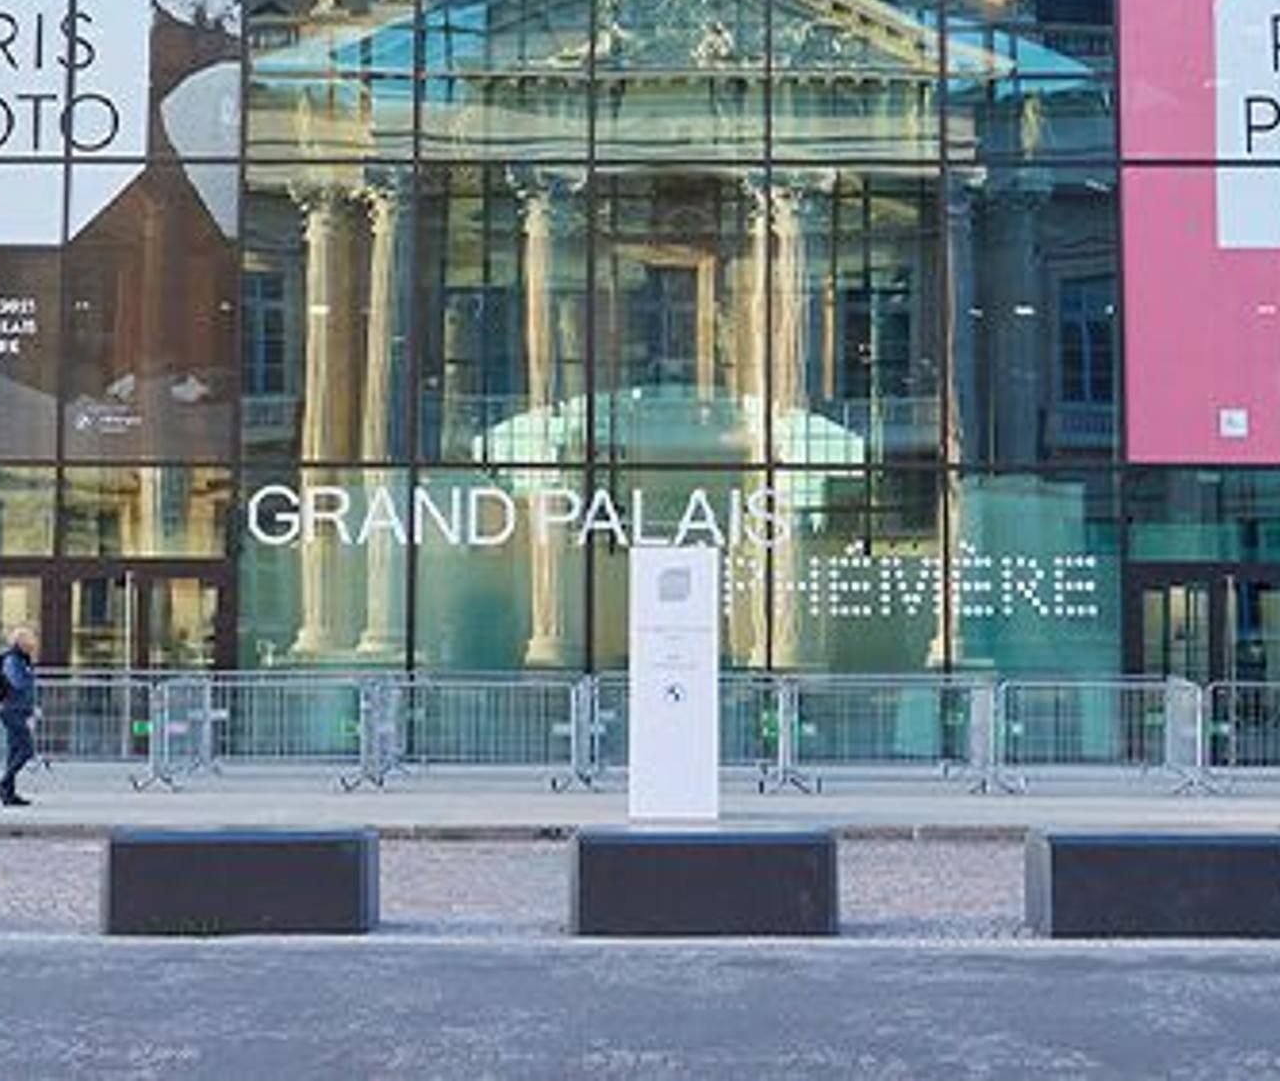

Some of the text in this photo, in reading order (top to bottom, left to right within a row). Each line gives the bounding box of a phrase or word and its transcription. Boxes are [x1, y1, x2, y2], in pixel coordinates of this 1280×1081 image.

[247, 484, 791, 549] GRAND PALAIS
[723, 539, 1099, 615] PHÉMÈRE
